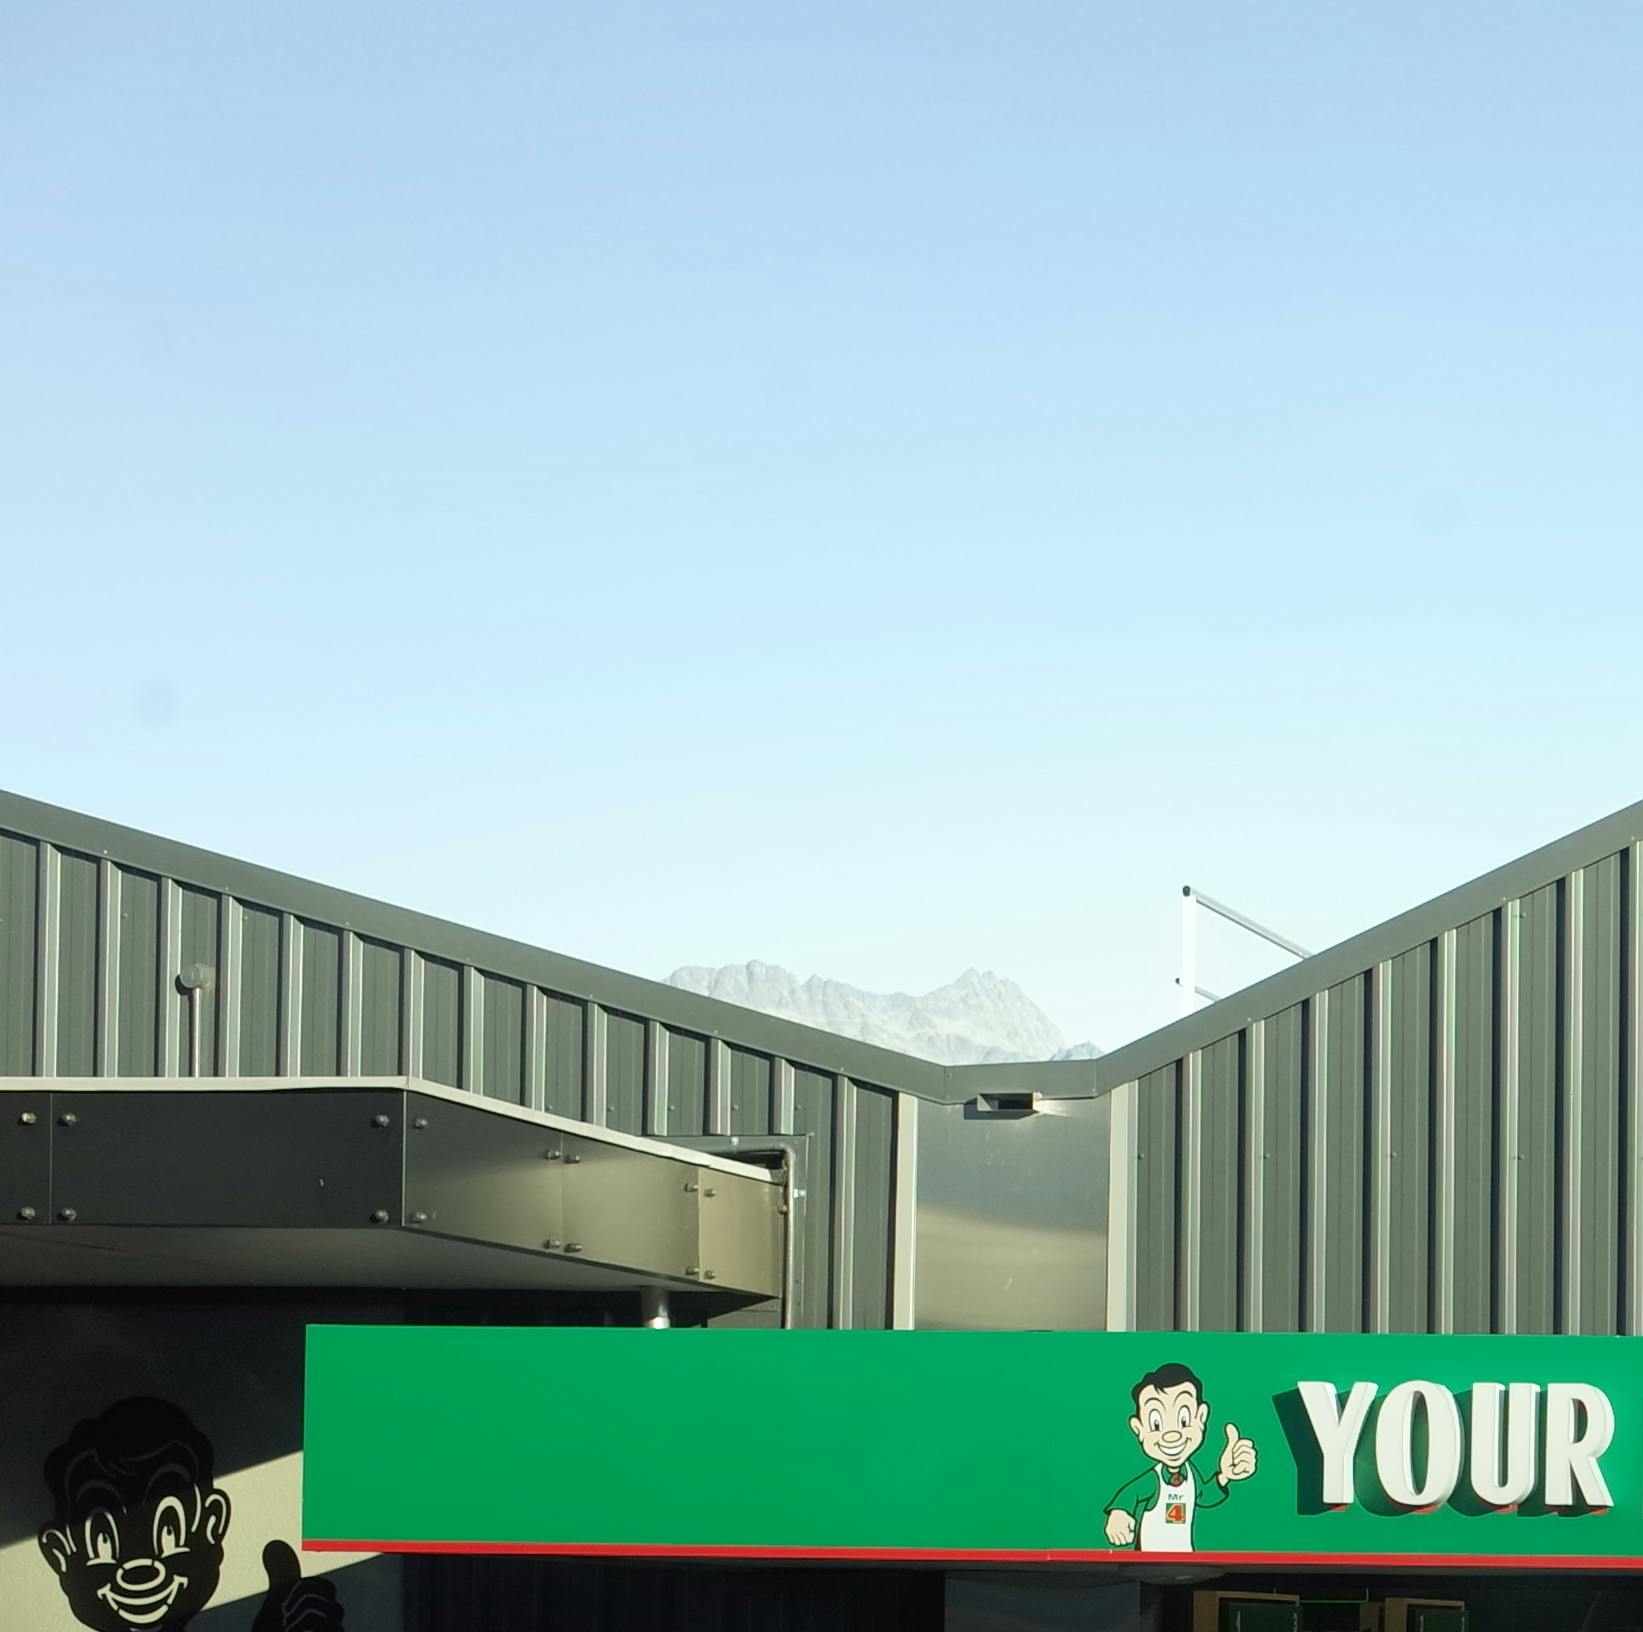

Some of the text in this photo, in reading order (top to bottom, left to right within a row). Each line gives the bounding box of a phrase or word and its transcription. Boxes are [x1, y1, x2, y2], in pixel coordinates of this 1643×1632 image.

[1298, 1380, 1615, 1509] YOUR
[1168, 1493, 1184, 1501] Mr
[1166, 1503, 1185, 1524] 4
